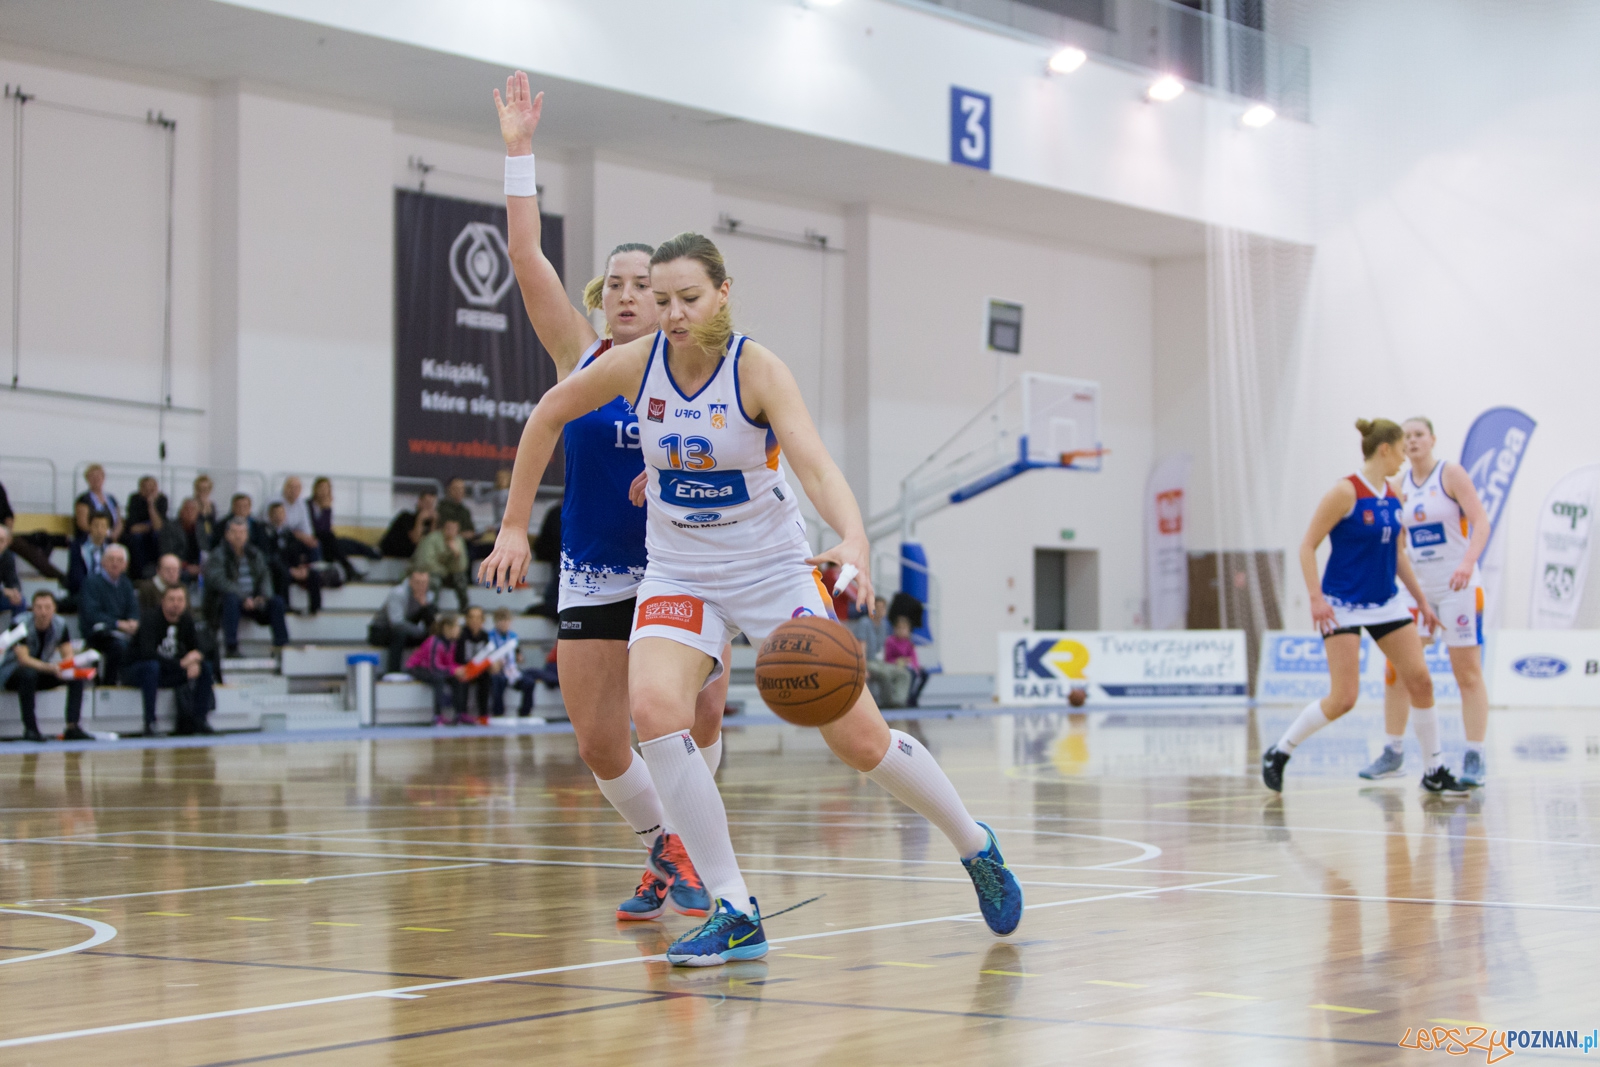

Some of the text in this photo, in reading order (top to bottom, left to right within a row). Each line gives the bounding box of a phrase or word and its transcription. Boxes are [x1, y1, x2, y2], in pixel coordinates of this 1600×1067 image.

[960, 94, 986, 160] 3
[421, 388, 468, 413] które
[658, 432, 717, 472] 13
[674, 482, 733, 499] Enea
[1414, 504, 1426, 522] 6
[646, 606, 693, 619] SZPIKU
[1098, 636, 1235, 659] Tworzymy
[758, 672, 820, 690] SPALDING
[1014, 684, 1088, 698] RAFL
